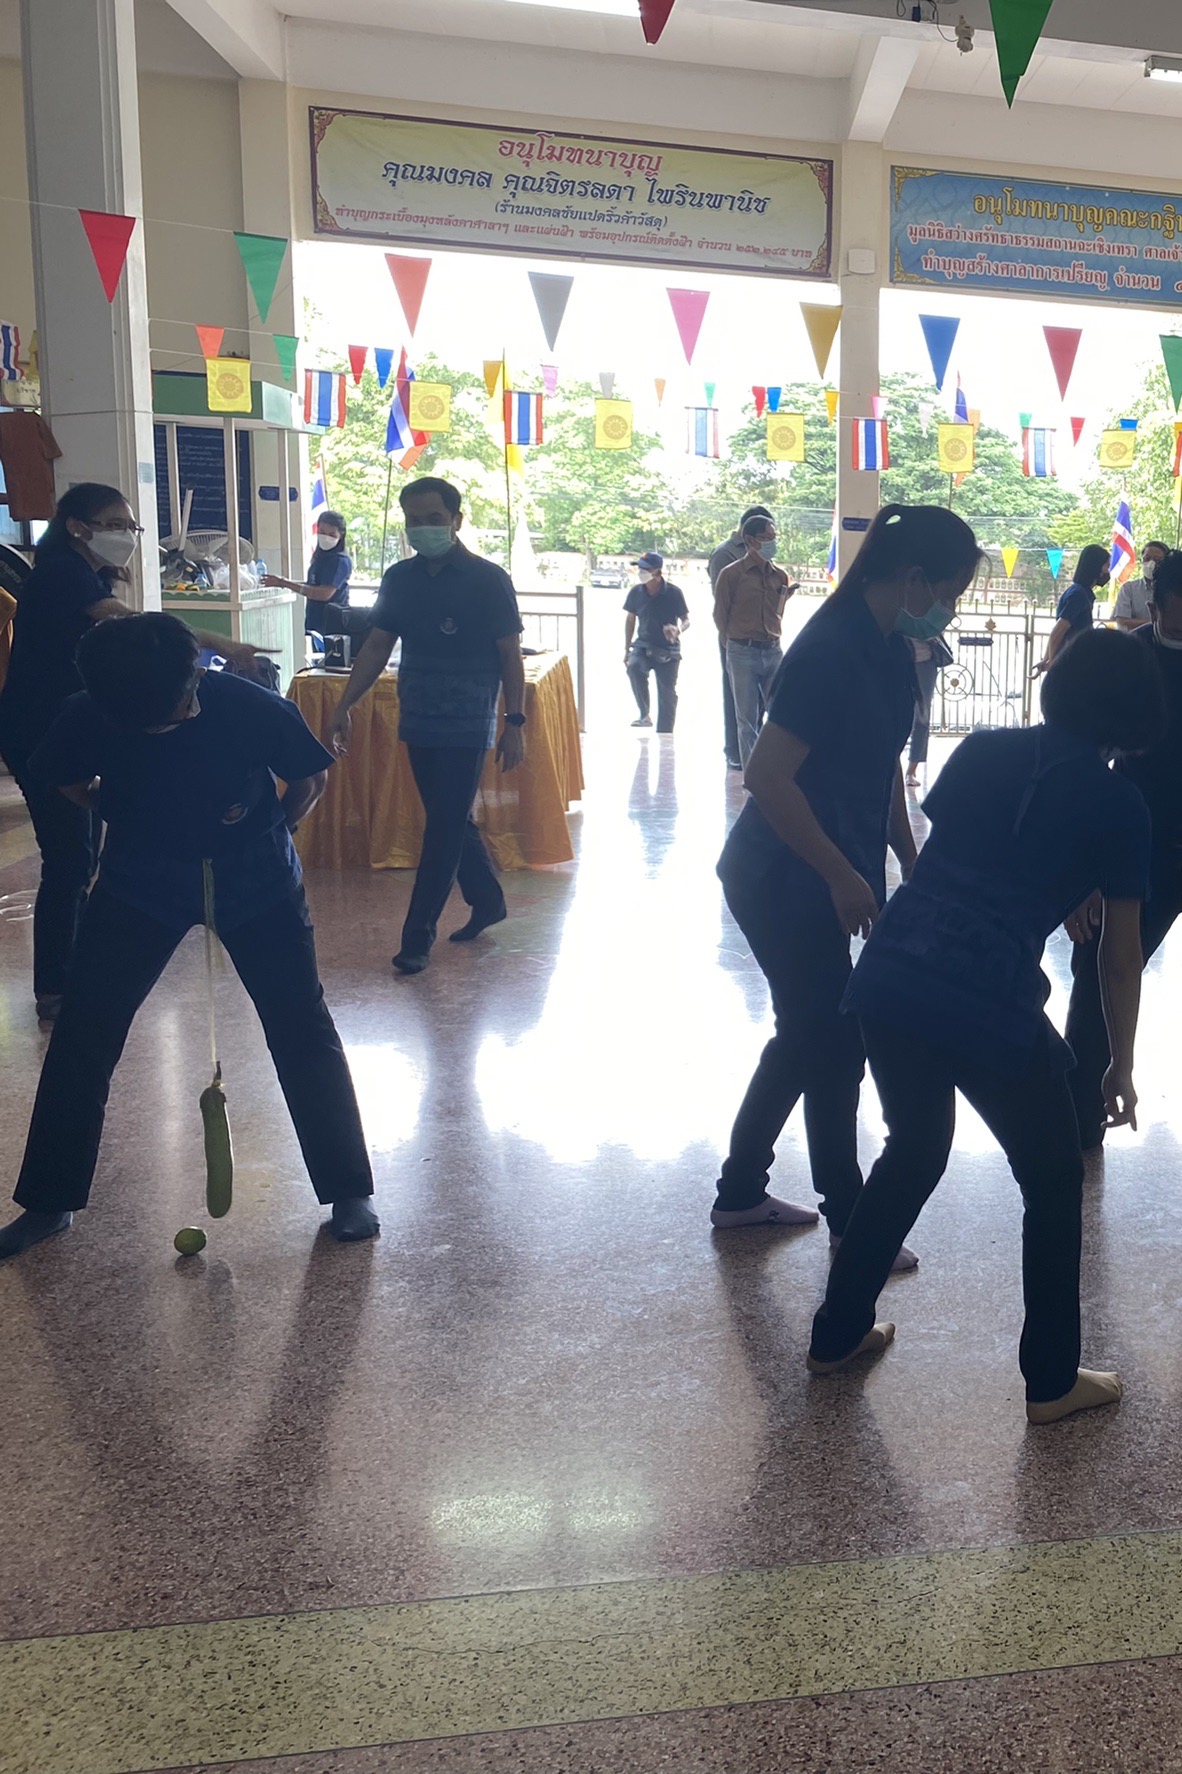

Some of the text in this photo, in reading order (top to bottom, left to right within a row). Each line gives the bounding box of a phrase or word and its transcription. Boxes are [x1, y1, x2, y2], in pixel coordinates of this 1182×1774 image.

[498, 132, 663, 177] อนุโมทนาบุญ
[382, 160, 771, 214] คุณมงคล คุณจิตรลดา ไพรินพานิช
[697, 237, 732, 251] จำนวน
[791, 248, 813, 258] บาท
[908, 222, 1138, 257] มูลนิธิสว่างศรัทธาธรรมสถานฉะเชิงเทรา
[921, 249, 1108, 290] ทำบุญสร้างศาลาการเปรียญ
[1114, 266, 1161, 290] จำนวน
